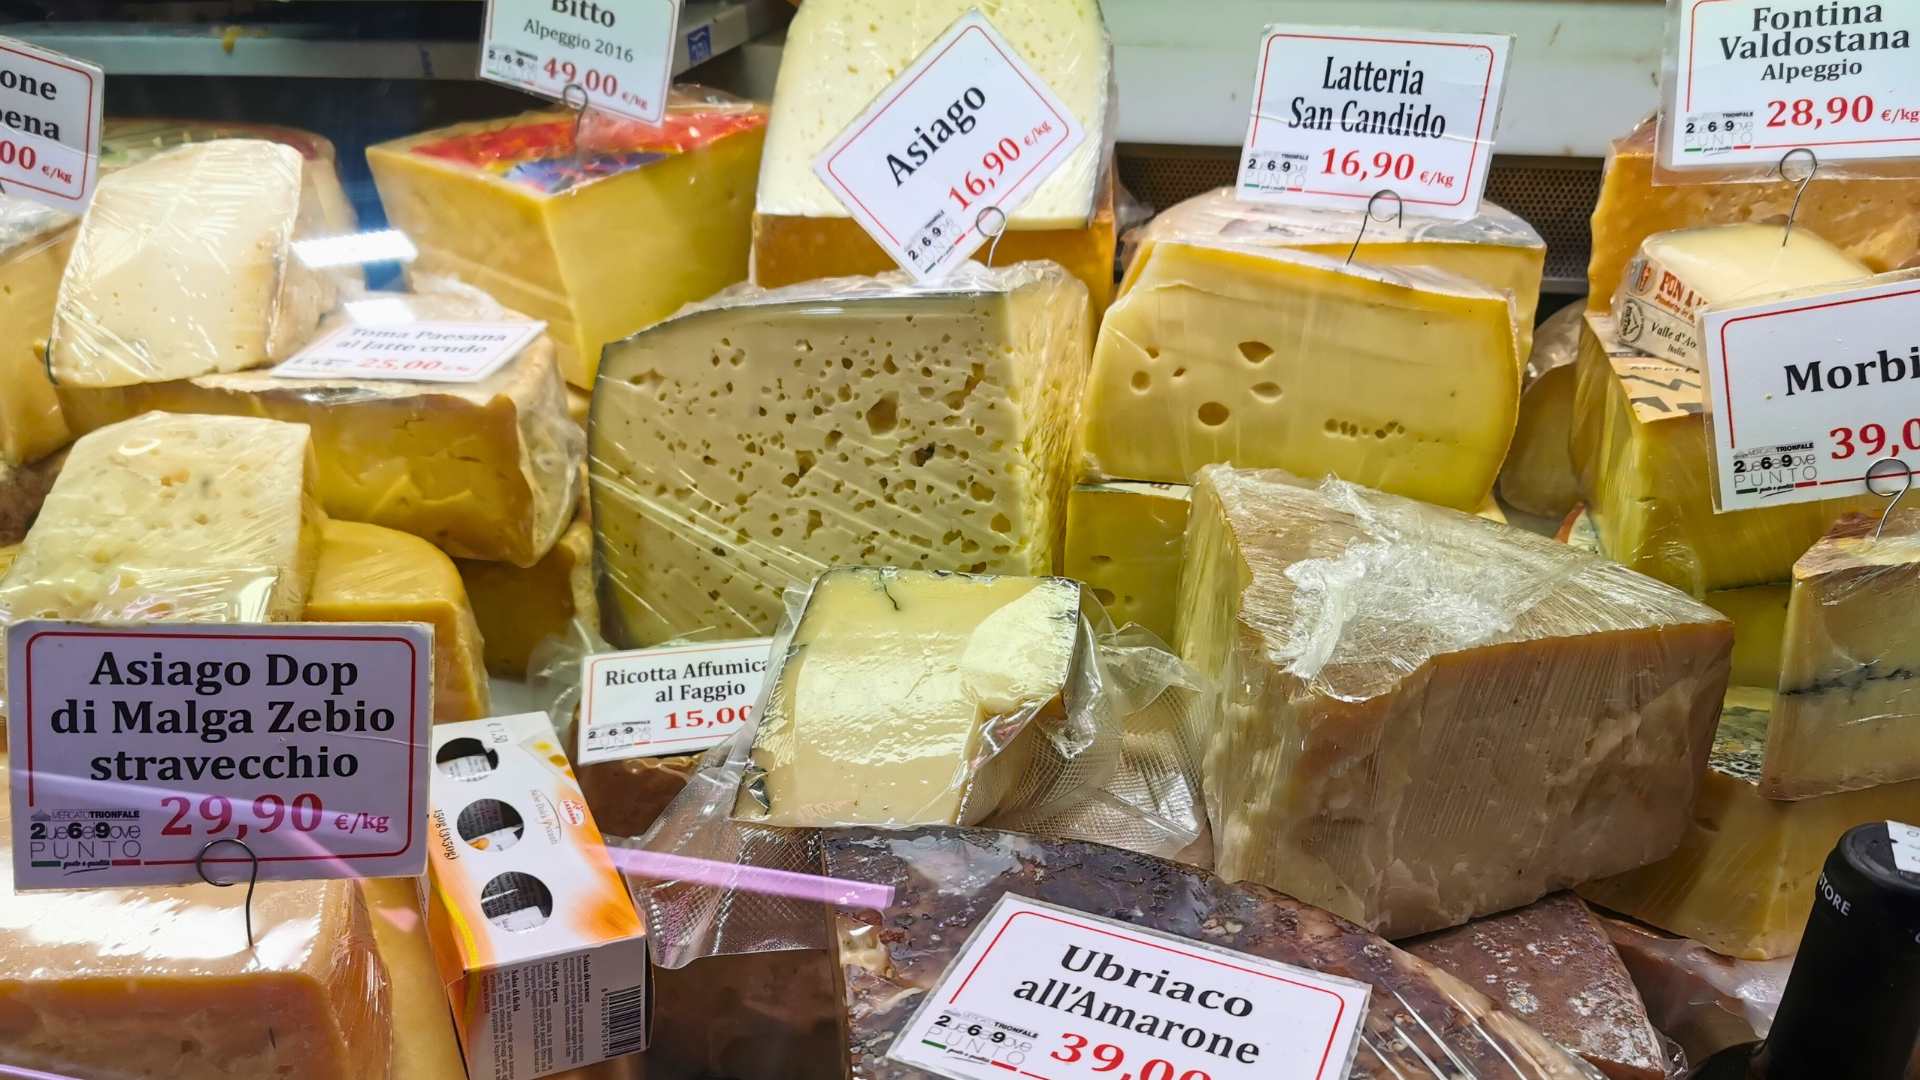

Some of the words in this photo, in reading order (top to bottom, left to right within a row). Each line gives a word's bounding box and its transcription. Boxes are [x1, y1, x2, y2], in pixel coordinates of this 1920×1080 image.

[1752, 2, 1883, 32] Fontina
[523, 19, 591, 50] Alpeggio
[595, 38, 634, 63] 2016
[1720, 29, 1910, 60] Valdostana
[1322, 56, 1424, 95] Latteria
[1760, 59, 1863, 84] Alpeggio
[0, 109, 61, 141] ena
[1288, 97, 1333, 132] San
[1342, 100, 1446, 138] Candido
[1767, 95, 1874, 129] 28,90
[1880, 108, 1920, 123] €/kg
[886, 87, 986, 188] Asiago
[41, 165, 73, 184] €/kg
[949, 136, 1021, 211] 16,90
[1024, 121, 1052, 147] €/kg
[1320, 148, 1415, 182] 16,90
[1420, 170, 1454, 188] €/kg
[336, 340, 359, 349] al
[362, 341, 416, 352] latte
[420, 344, 488, 353] crudo
[416, 331, 507, 342] Paesana
[1651, 321, 1674, 339] Valle
[359, 357, 444, 371] 25,00
[1784, 346, 1920, 396] Morbi
[1734, 466, 1818, 488] PUNTO
[89, 652, 252, 696] Asiago
[265, 654, 359, 696] Dop
[605, 666, 676, 687] Ricotta
[655, 686, 674, 703] al
[680, 681, 746, 703] Faggio
[51, 700, 97, 734] di
[112, 700, 254, 744] Malga
[268, 700, 395, 734] Zebio
[90, 745, 359, 782] stravecchio
[160, 792, 323, 840] 29,90
[334, 811, 390, 833] €/kg
[30, 840, 142, 859] PUNTO
[1819, 872, 1852, 917] TORE
[1059, 944, 1254, 1020] Ubriaco
[1013, 978, 1260, 1065] all'Amarone
[924, 1026, 1026, 1065] PUNTO
